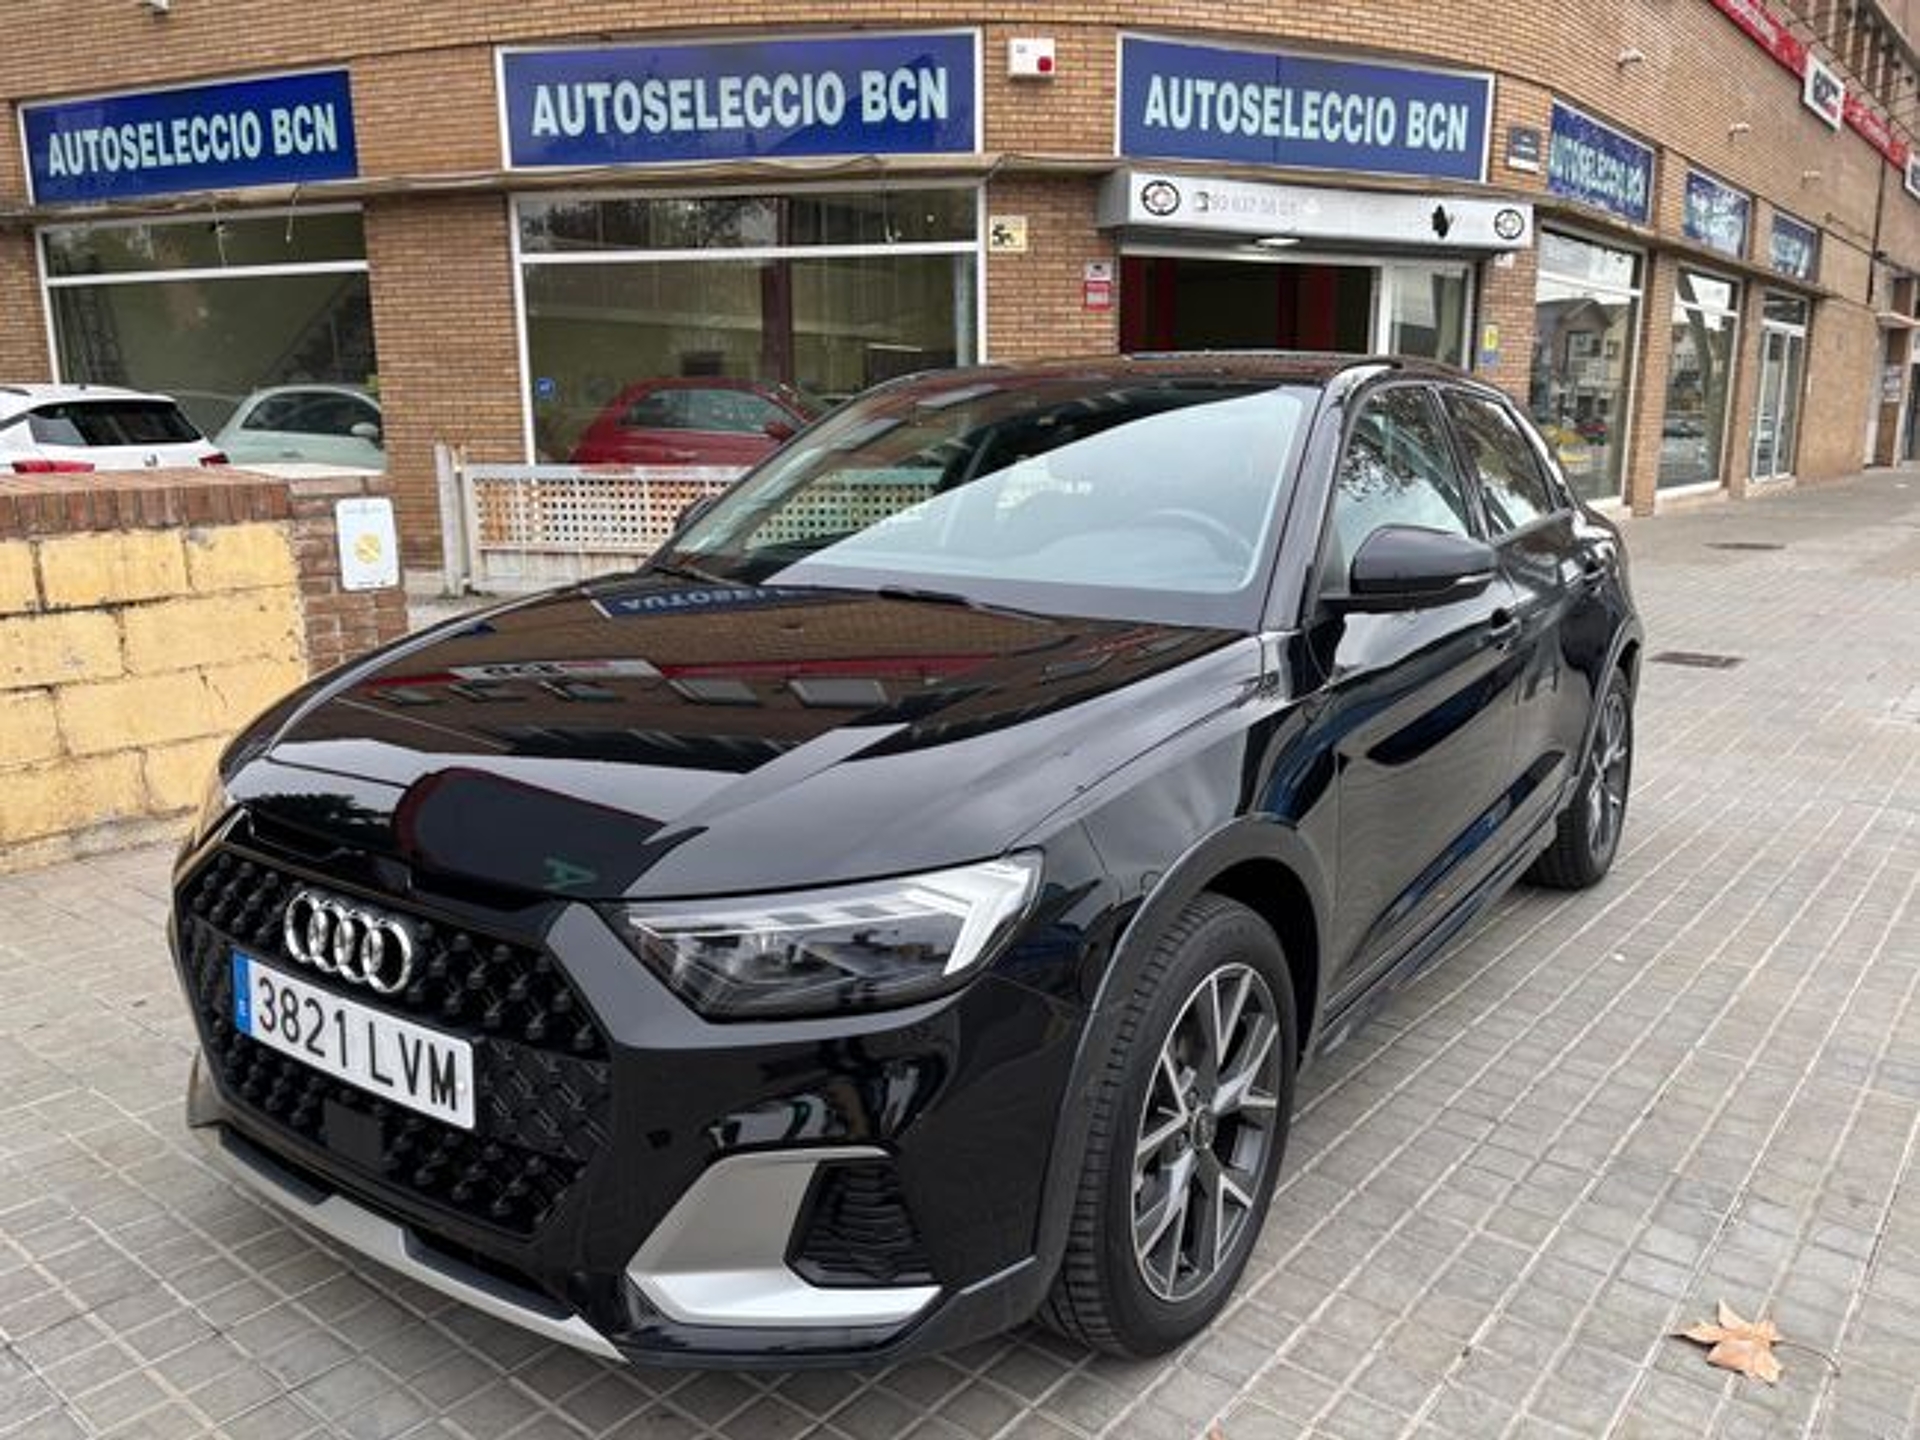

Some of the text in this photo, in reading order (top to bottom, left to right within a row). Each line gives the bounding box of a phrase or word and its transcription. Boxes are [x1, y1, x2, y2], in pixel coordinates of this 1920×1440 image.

[532, 66, 949, 137] AUTOSELECCIO BCN
[1142, 74, 1398, 147] AUTOSELECCIO
[1405, 99, 1470, 153] BCN
[48, 103, 337, 178] AUTOSELECCIO BCN
[259, 976, 456, 1112] 3821 LVM
